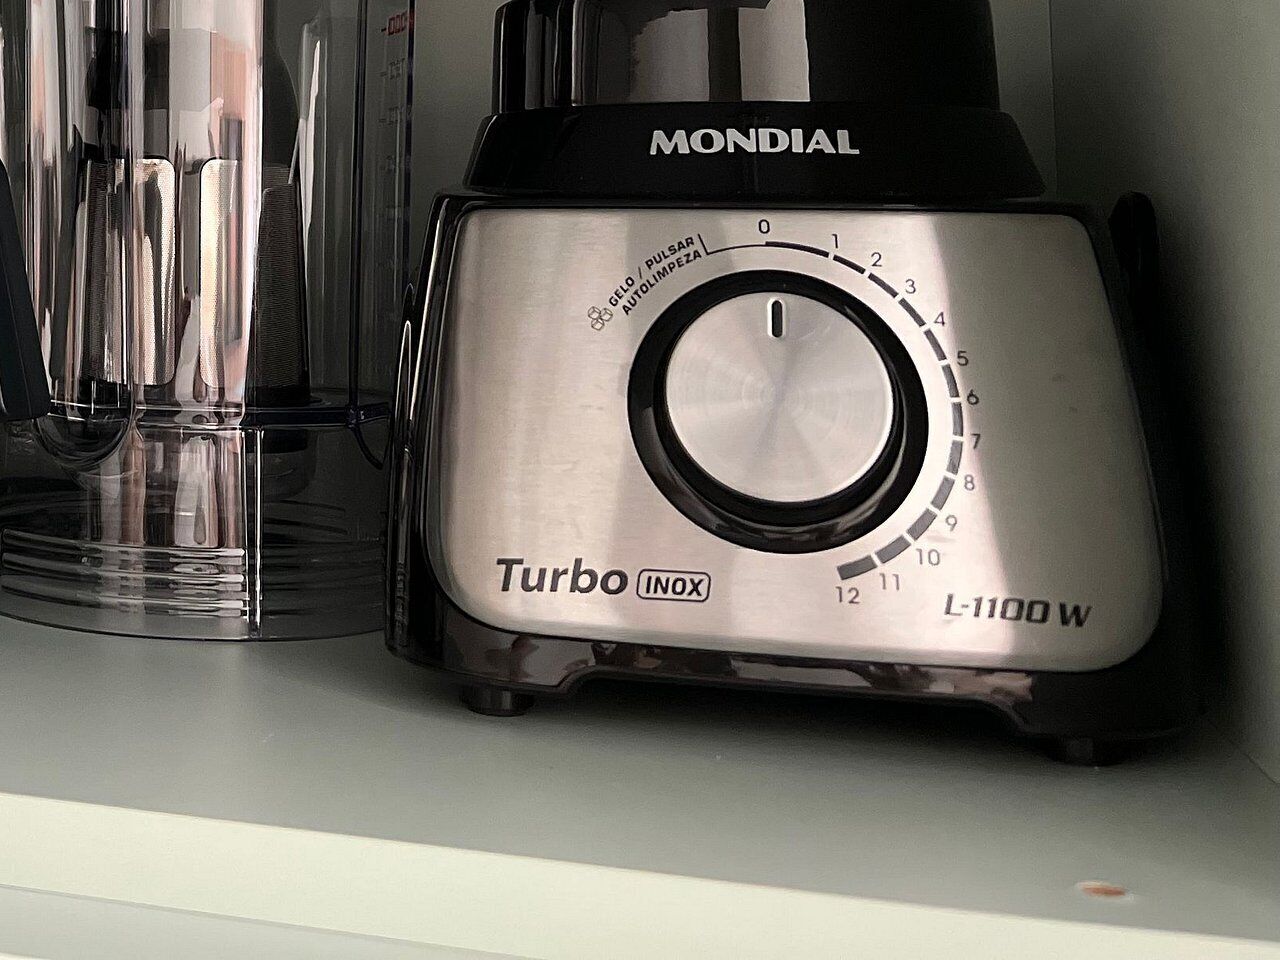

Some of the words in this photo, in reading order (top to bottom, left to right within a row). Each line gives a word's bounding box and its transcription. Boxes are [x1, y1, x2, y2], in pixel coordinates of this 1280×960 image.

[649, 128, 860, 155] MONDIAL
[757, 219, 771, 235] 0
[831, 233, 841, 250] 1
[870, 253, 884, 268] 2
[608, 276, 635, 307] GELO
[644, 236, 695, 270] PULSAR
[621, 249, 702, 316] AUTOLIMPEZA
[905, 278, 918, 295] 3
[933, 311, 947, 327] 4
[956, 351, 970, 366] 5
[966, 389, 980, 406] 6
[970, 433, 982, 450] 7
[963, 474, 976, 492] 8
[944, 514, 958, 532] 9
[915, 548, 941, 566] 10
[496, 557, 629, 596] Turbo
[644, 575, 705, 598] INOX
[878, 572, 902, 591] 11
[834, 586, 861, 605] 12
[944, 593, 1051, 625] L-1100
[1058, 602, 1093, 628] W
